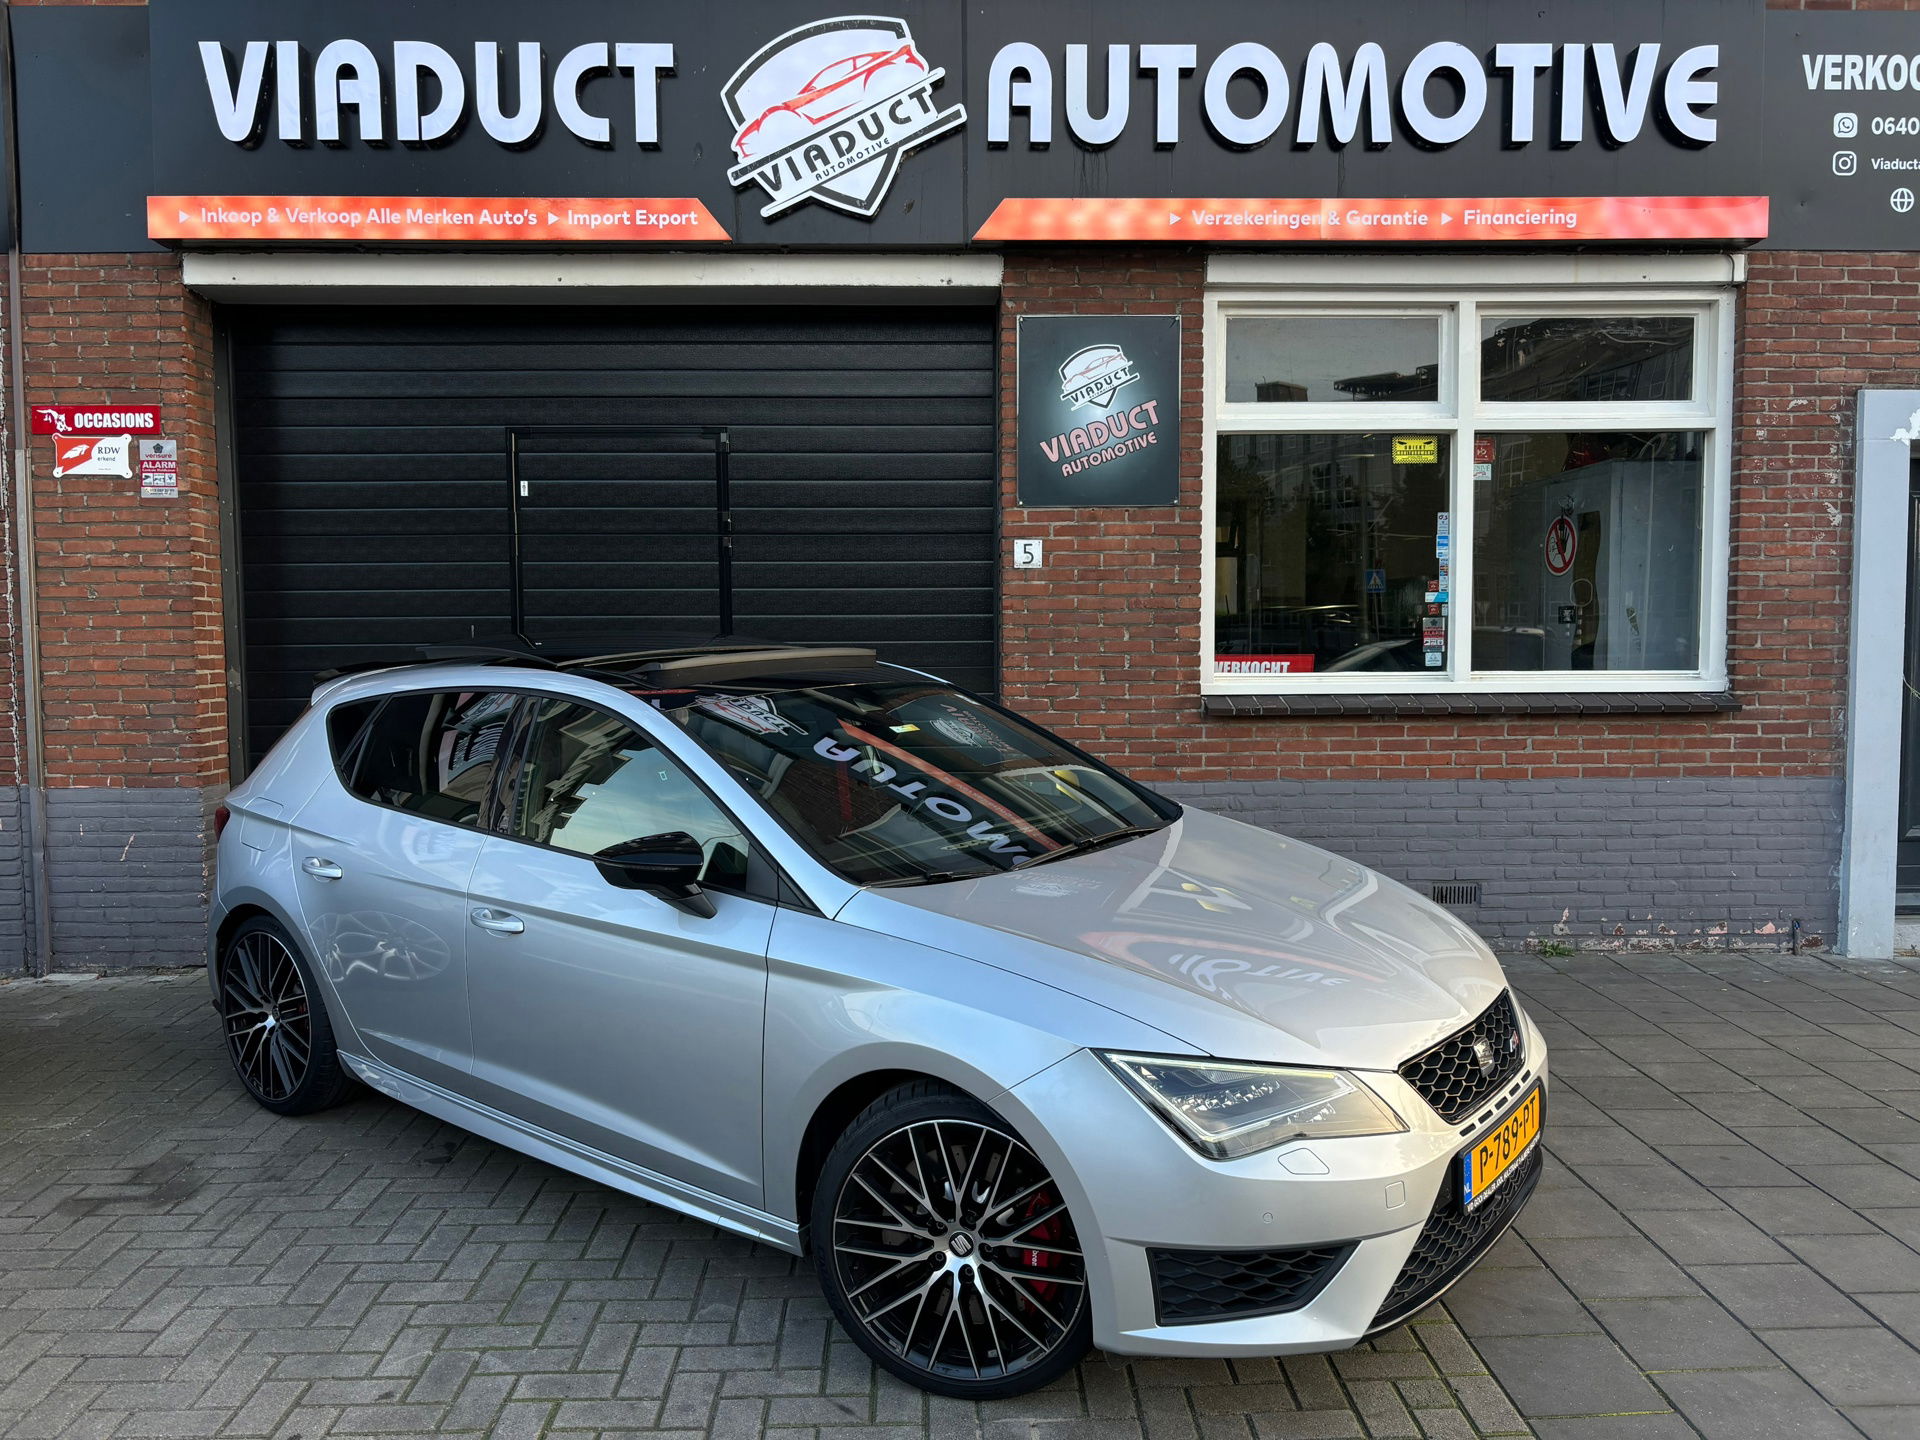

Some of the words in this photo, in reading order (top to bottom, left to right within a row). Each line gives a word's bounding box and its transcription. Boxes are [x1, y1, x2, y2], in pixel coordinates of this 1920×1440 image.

[198, 39, 675, 145] VIADUCT
[987, 41, 1720, 146] AUTOMOTIVE
[757, 86, 931, 192] VIADUCT
[814, 137, 891, 181] AUTOMOTIVE
[201, 207, 262, 226] Inkoop
[267, 207, 280, 223] &
[285, 208, 361, 227] Verkoop
[366, 208, 401, 224] Alle
[406, 208, 474, 224] Merken
[479, 208, 538, 225] Auto's
[568, 209, 630, 228] Import
[635, 210, 698, 228] Export
[1192, 209, 1322, 229] Verzekeringen
[1327, 210, 1340, 225] &
[1346, 209, 1429, 225] Garantie
[1464, 208, 1577, 228] Financiering
[1070, 367, 1129, 403] VIADUCT
[74, 412, 154, 428] OCCASIONS
[1039, 399, 1160, 463] VIADUCT
[97, 446, 121, 454] RDW
[1060, 431, 1158, 477] AUTOMOTIVE
[142, 461, 176, 469] ALARM
[1022, 543, 1034, 564] 5
[1214, 661, 1290, 673] VERKOCHT
[1479, 1095, 1536, 1184] P-789-PT
